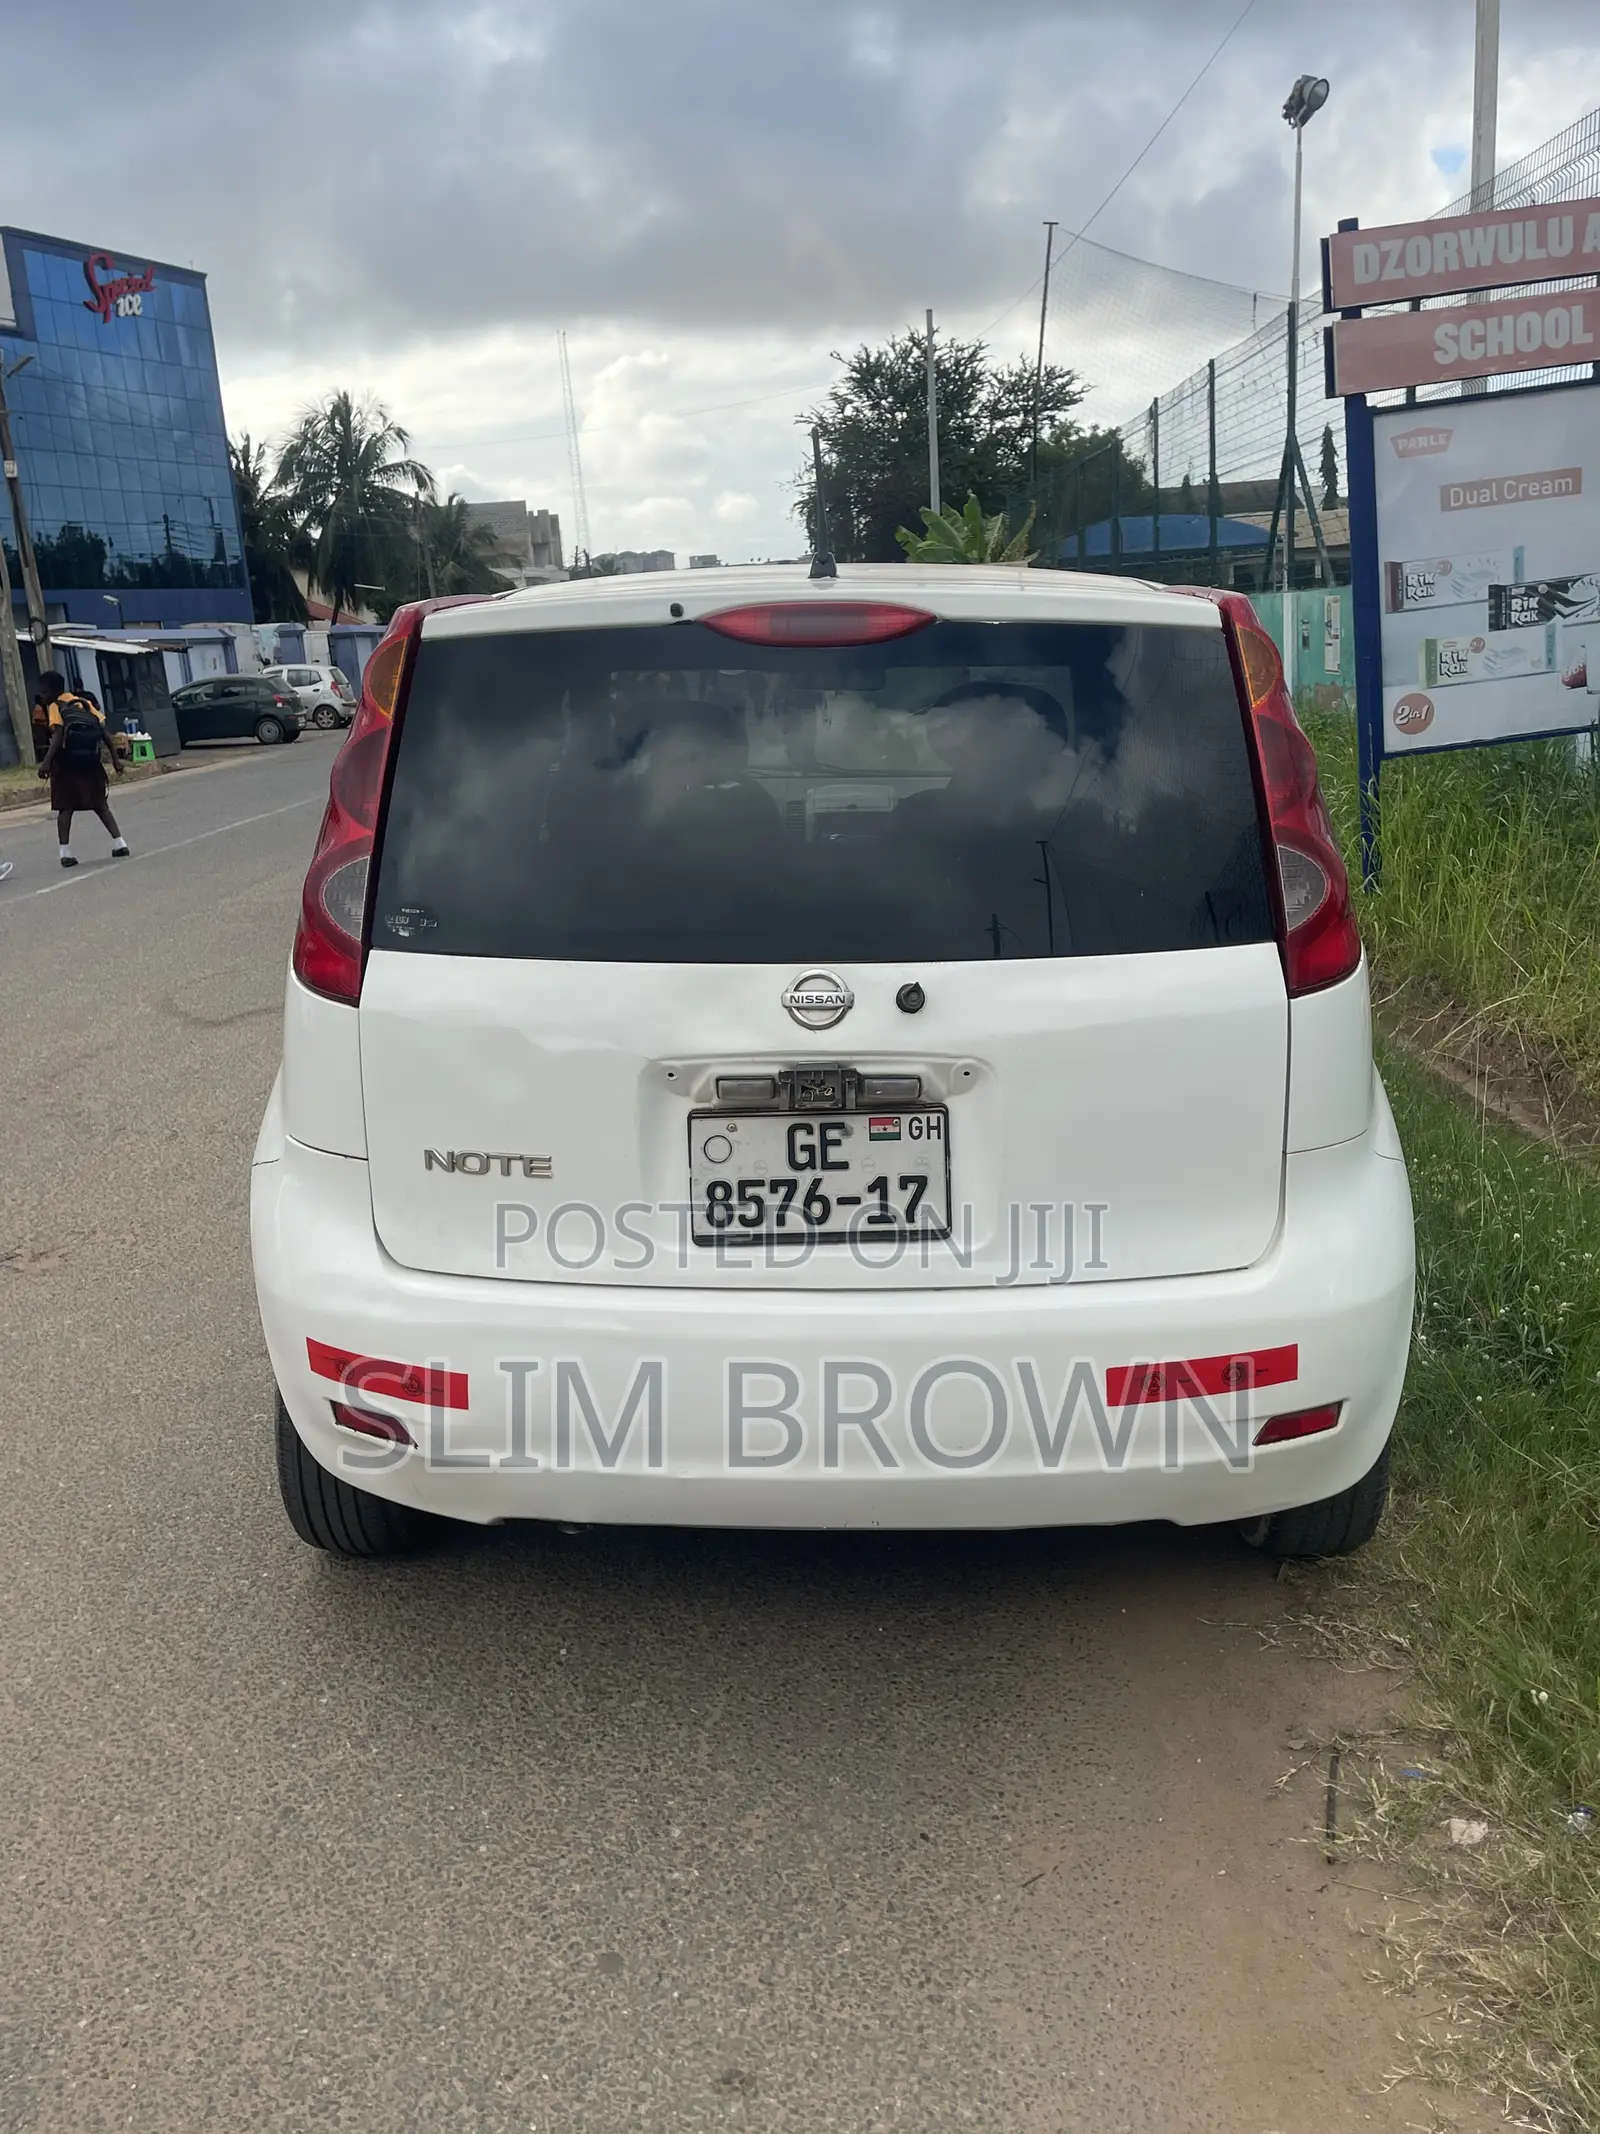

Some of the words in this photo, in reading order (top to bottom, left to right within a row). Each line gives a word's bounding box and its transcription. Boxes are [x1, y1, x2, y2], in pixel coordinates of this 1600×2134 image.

[1353, 215, 1574, 285] DZORWULU
[1434, 305, 1594, 365] SCHOOL
[1397, 433, 1448, 451] PARLE
[1450, 483, 1498, 507] Dual
[1503, 476, 1573, 500] Cream
[789, 994, 846, 1004] NISSAN
[908, 1115, 941, 1141] GH
[787, 1122, 849, 1171] GE
[424, 1147, 552, 1178] NOTE
[705, 1175, 928, 1228] 8576-17
